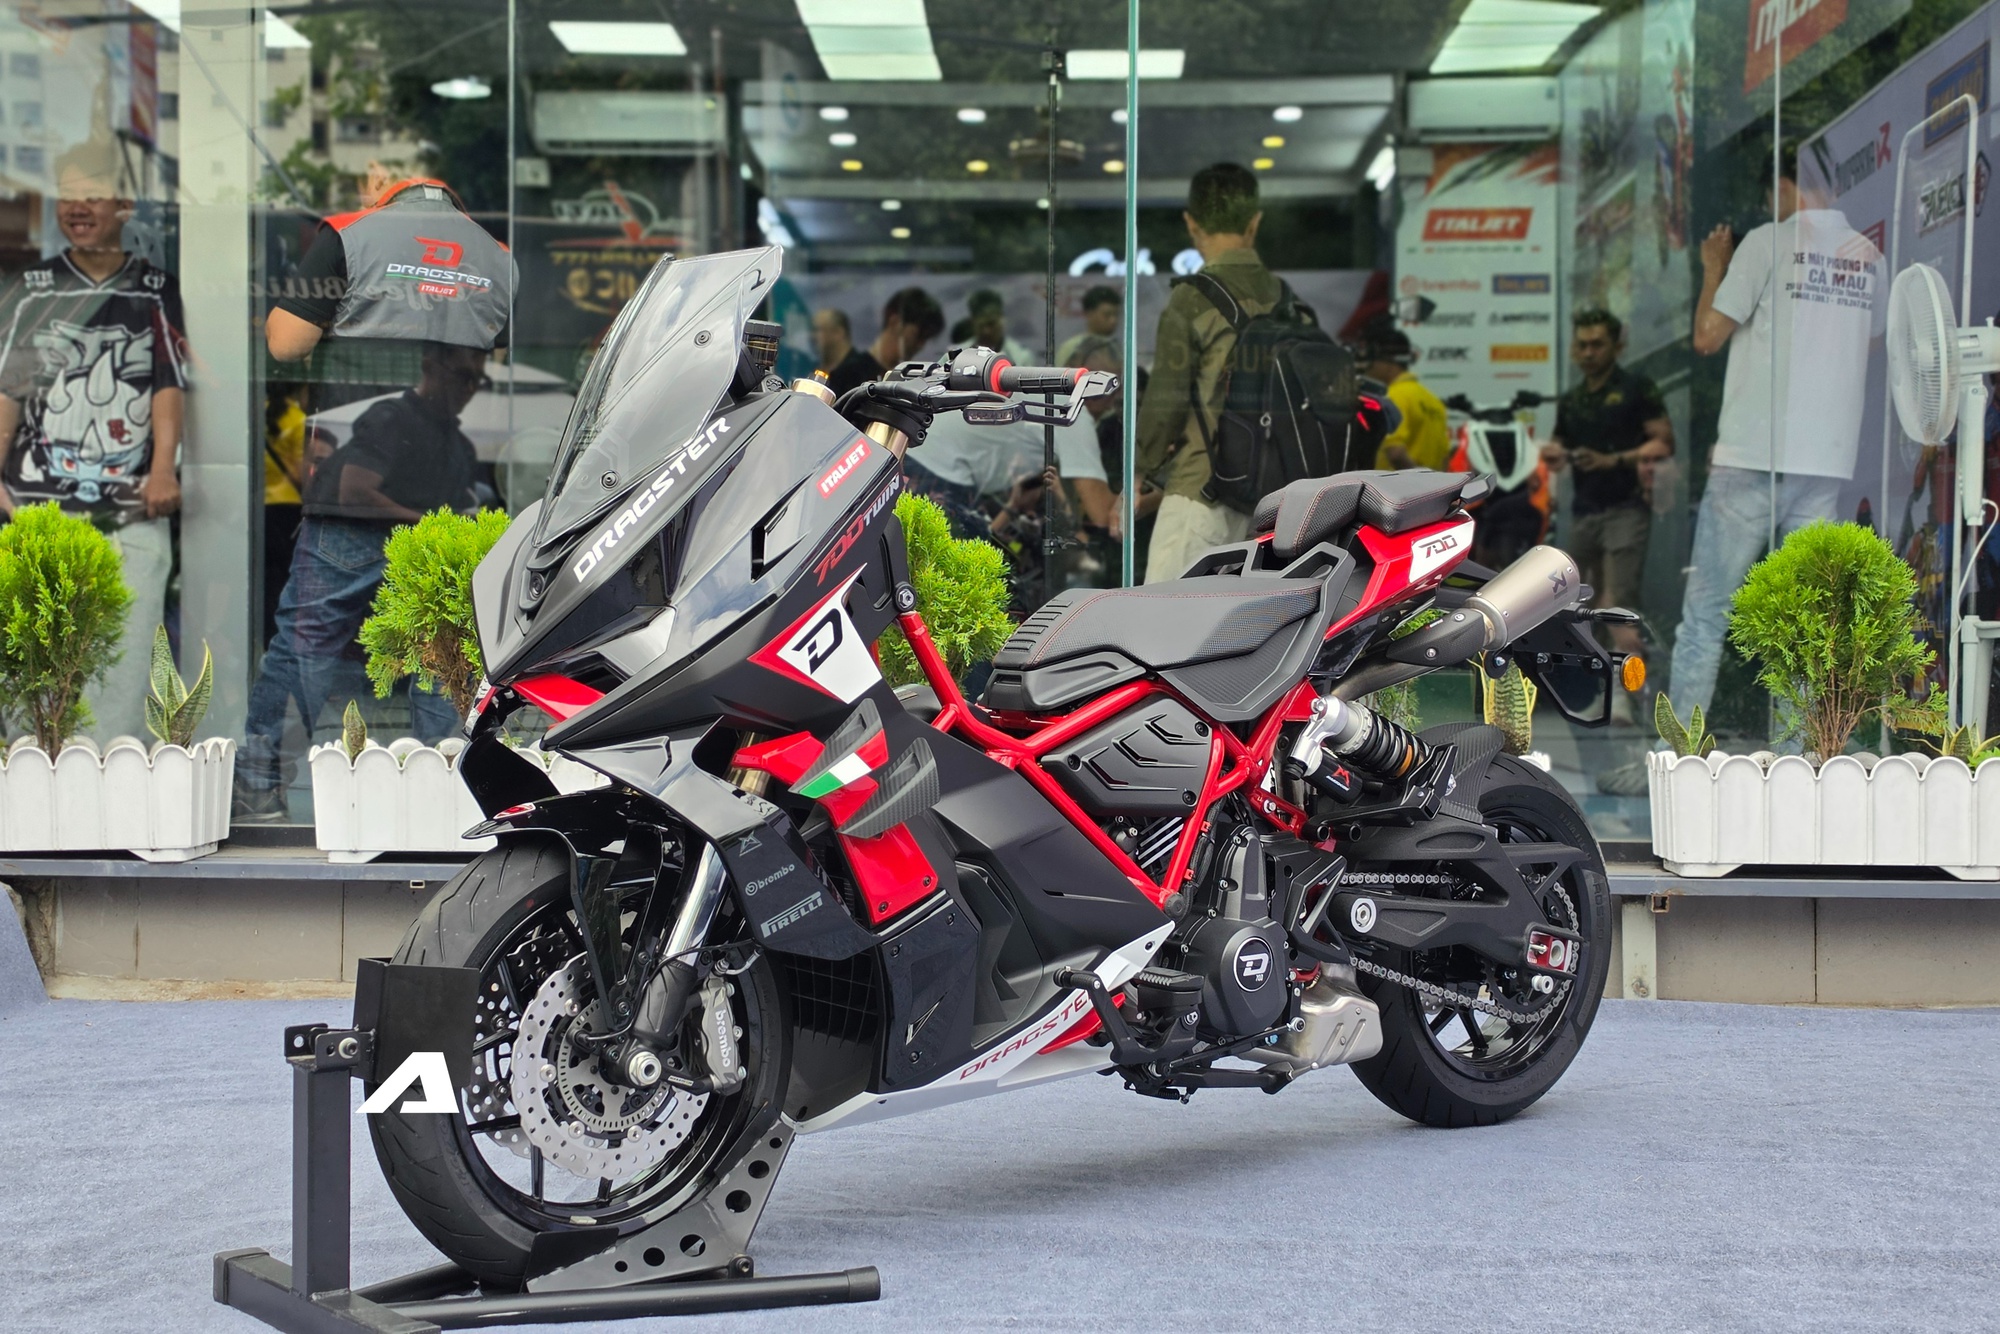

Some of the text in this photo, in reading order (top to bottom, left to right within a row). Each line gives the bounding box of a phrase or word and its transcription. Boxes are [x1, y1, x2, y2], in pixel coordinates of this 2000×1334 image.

[386, 263, 493, 288] DRAGSTER
[420, 284, 456, 295] ITALJET
[1832, 273, 1867, 291] MAU
[820, 443, 867, 494] ITALJET
[573, 416, 731, 584] DRAGSTER
[862, 473, 900, 527] TWIN
[1418, 534, 1458, 558] 700
[791, 607, 843, 674] D
[757, 863, 795, 889] brembo
[761, 891, 822, 938] PIRELLI
[1239, 953, 1269, 977] D
[715, 1009, 732, 1067] brembo
[959, 989, 1091, 1081] DRAGSTE
